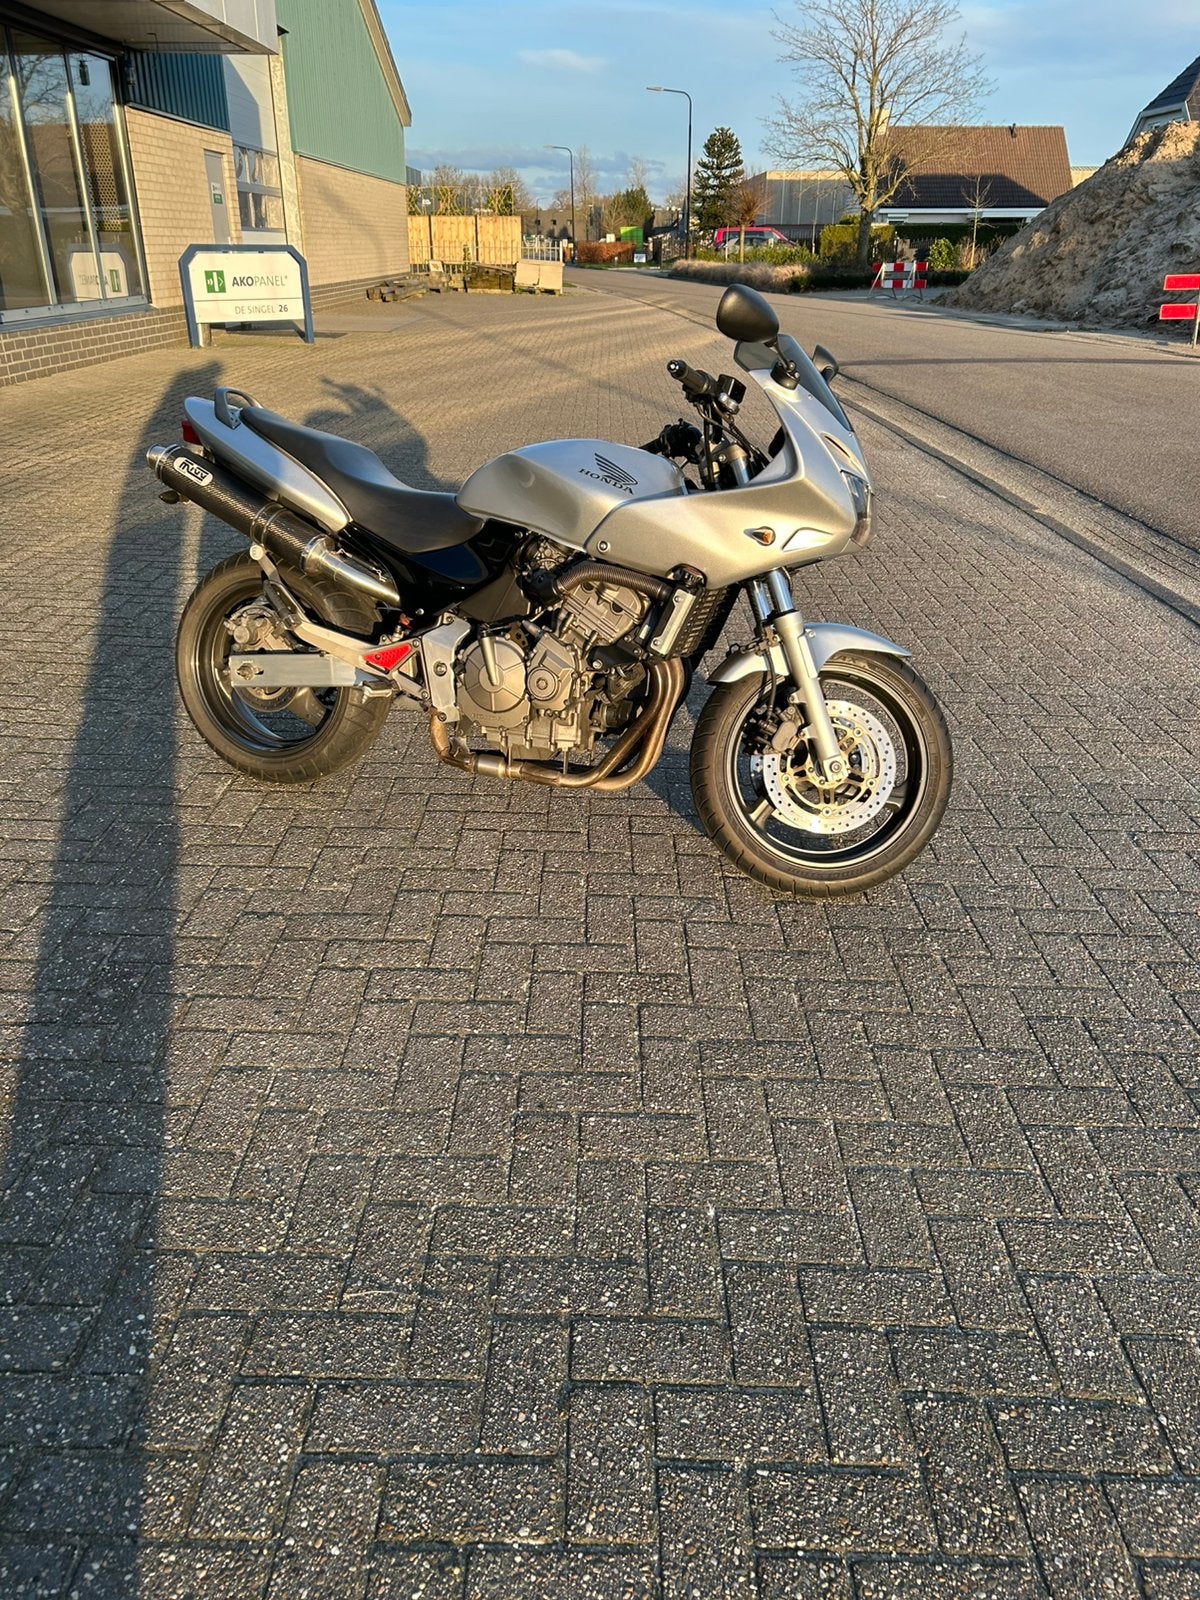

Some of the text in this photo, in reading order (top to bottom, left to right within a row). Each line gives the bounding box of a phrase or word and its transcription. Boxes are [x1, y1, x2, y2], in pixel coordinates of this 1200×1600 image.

[235, 304, 289, 315] DE SINGEL 26
[578, 468, 634, 495] HONDA
